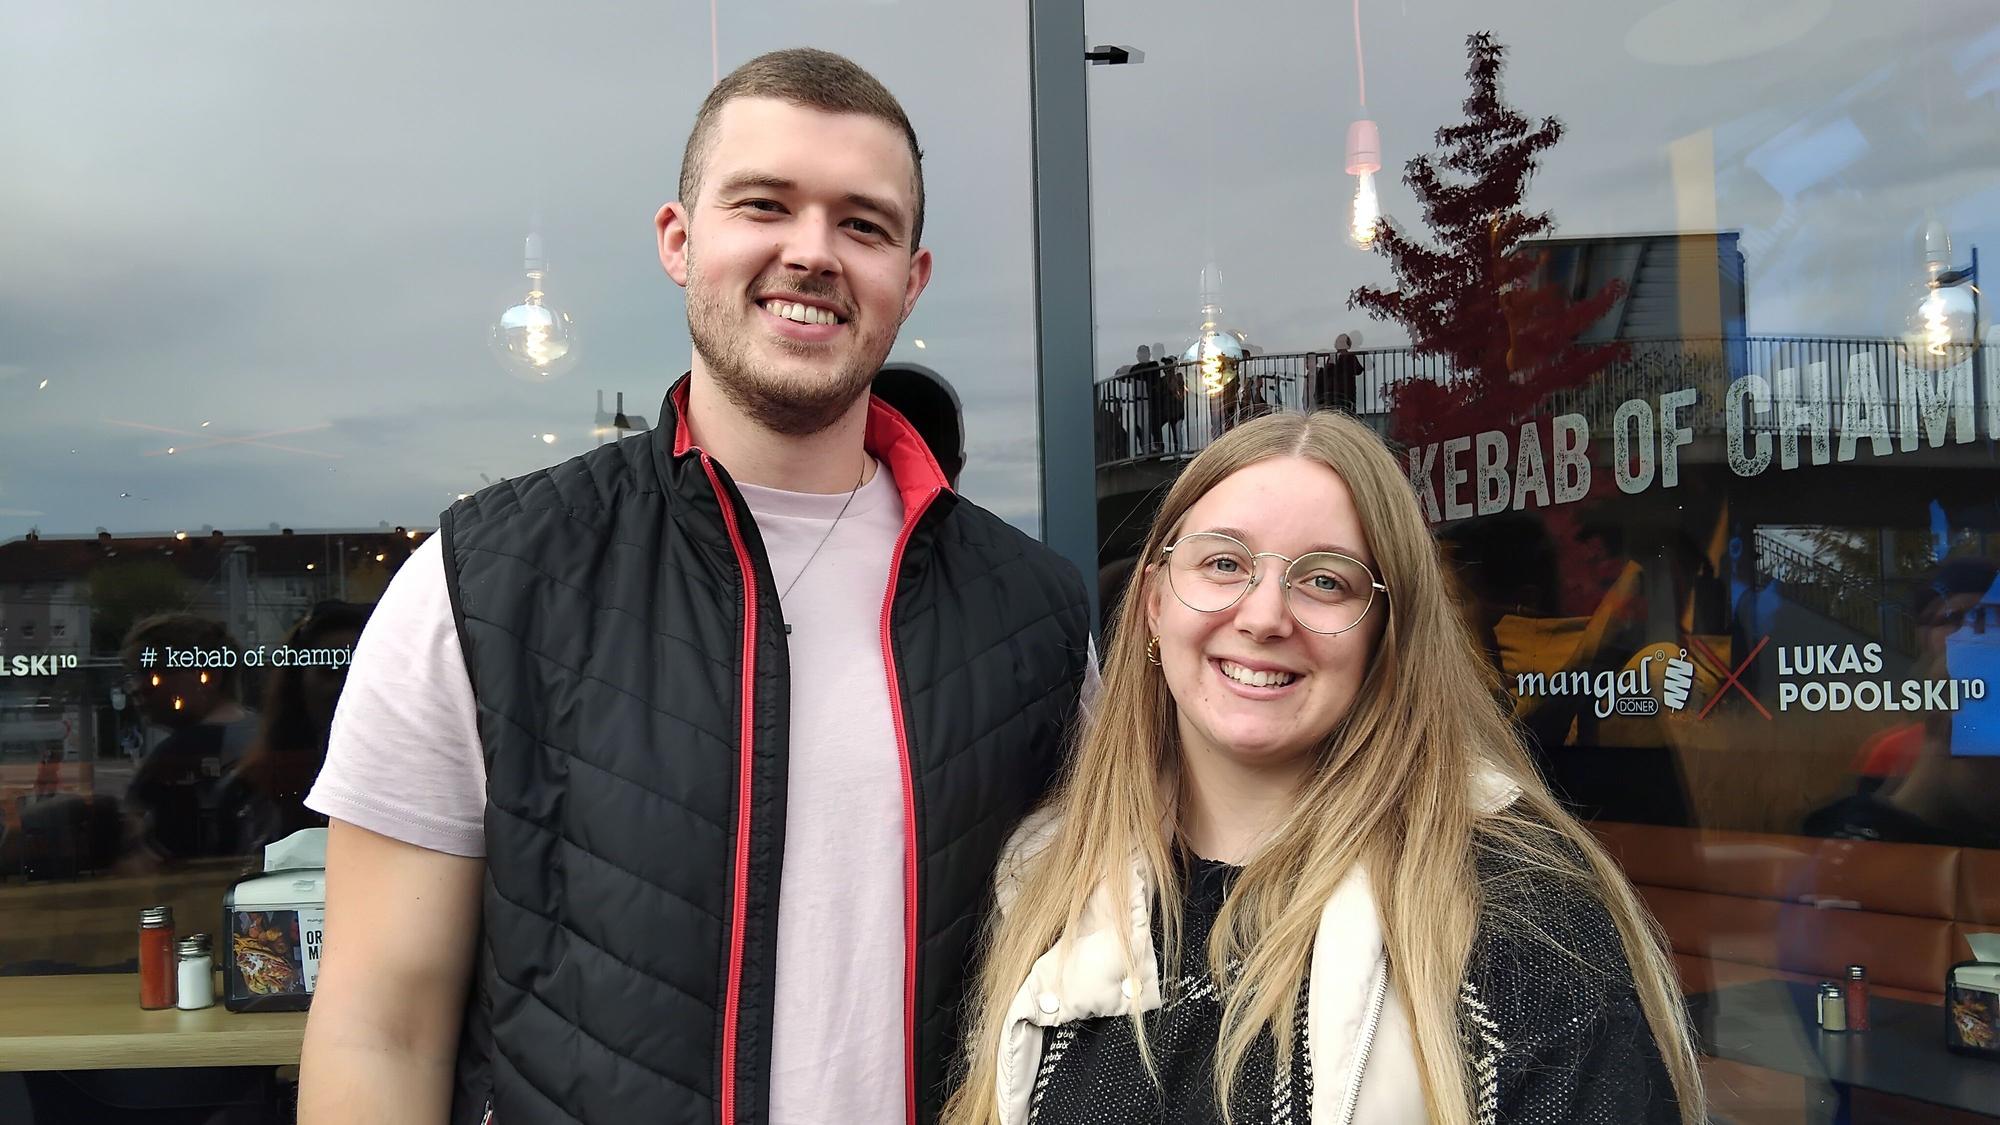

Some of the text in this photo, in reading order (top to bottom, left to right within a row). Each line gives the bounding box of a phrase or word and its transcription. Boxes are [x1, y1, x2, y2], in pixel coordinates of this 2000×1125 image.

[1409, 412, 1591, 523] KEBAB
[1613, 388, 1697, 494] OF
[165, 646, 237, 668] kebab
[243, 645, 265, 667] of
[1778, 642, 1883, 675] LUKAS
[1619, 698, 1655, 713] DÖNER
